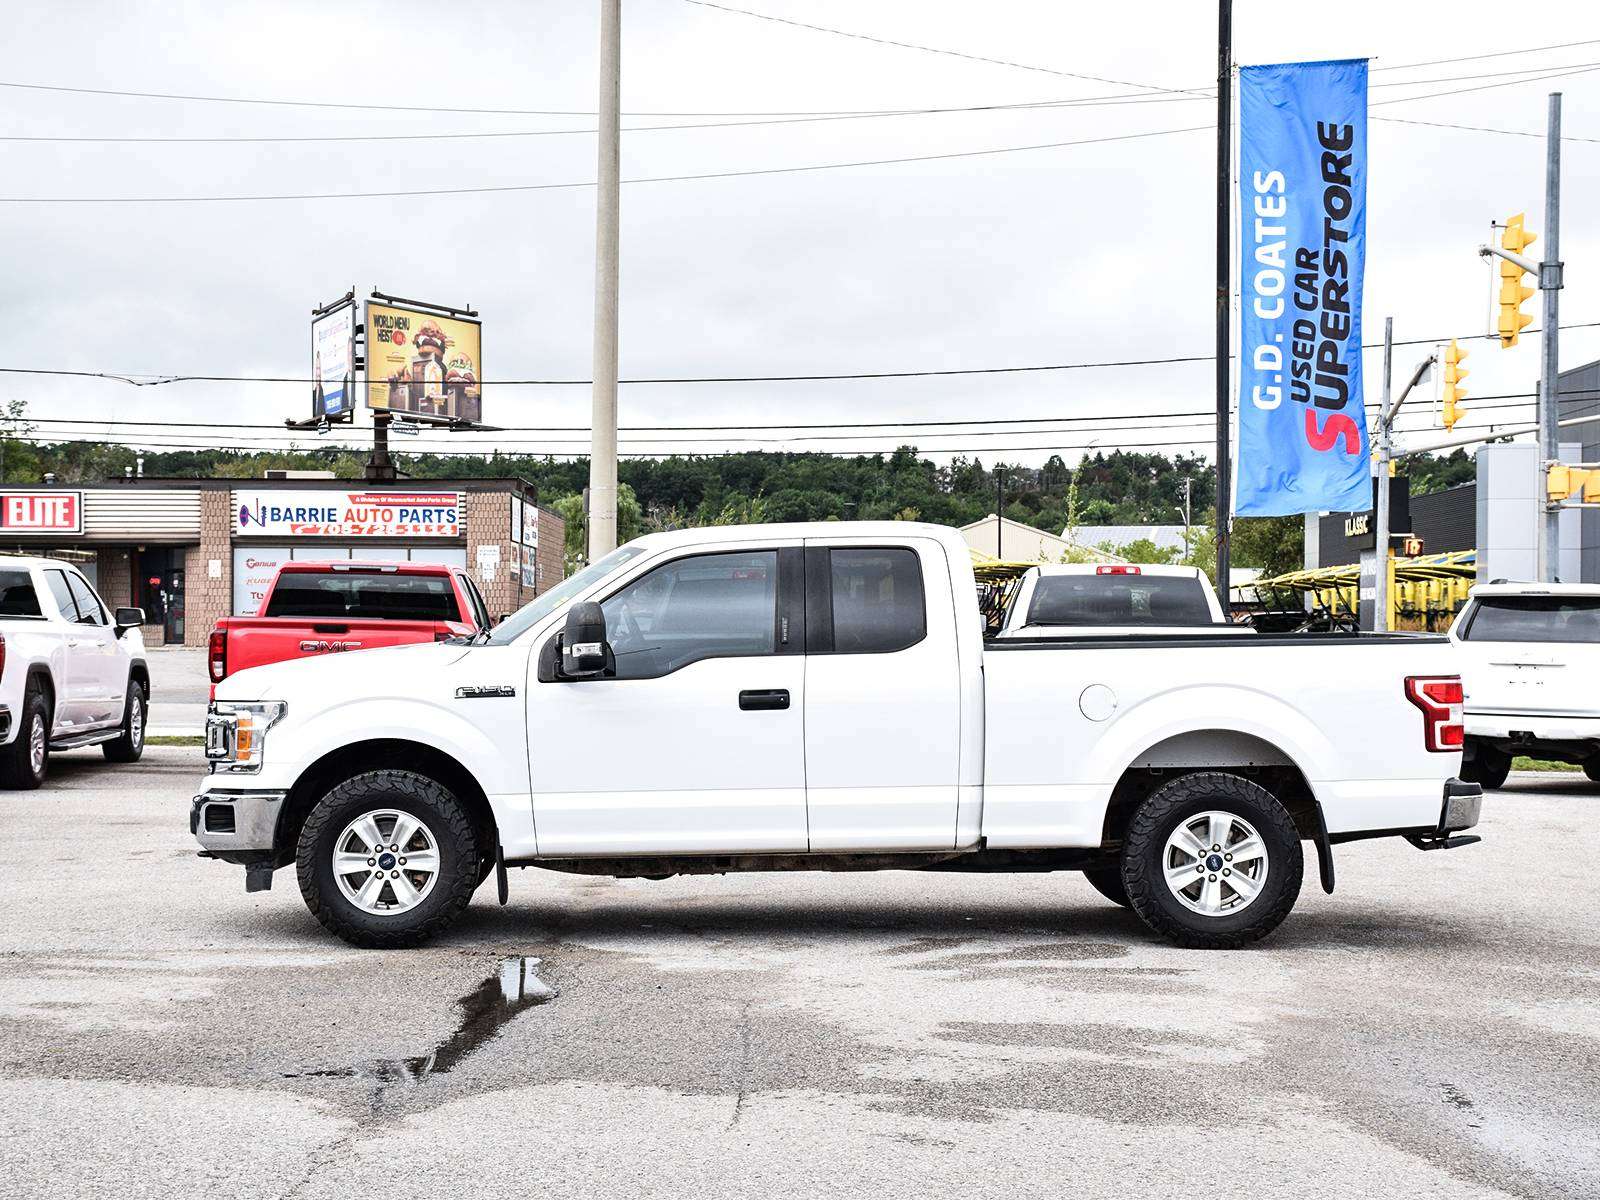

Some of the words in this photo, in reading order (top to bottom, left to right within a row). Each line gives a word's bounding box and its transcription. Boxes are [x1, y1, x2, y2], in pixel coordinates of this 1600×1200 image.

[1253, 171, 1286, 320] COATES
[1294, 247, 1319, 312] CAR
[1306, 121, 1360, 455] SUPERSTORE
[373, 314, 394, 329] WORLD
[394, 316, 410, 331] MENU
[377, 328, 393, 343] HEIST
[1252, 344, 1283, 410] G.D.
[1291, 320, 1316, 403] USED
[8, 497, 69, 526] ELITE
[270, 507, 337, 523] BARRIE
[344, 508, 393, 523] AUTO
[399, 508, 457, 524] PARTS
[300, 640, 362, 653] GMC
